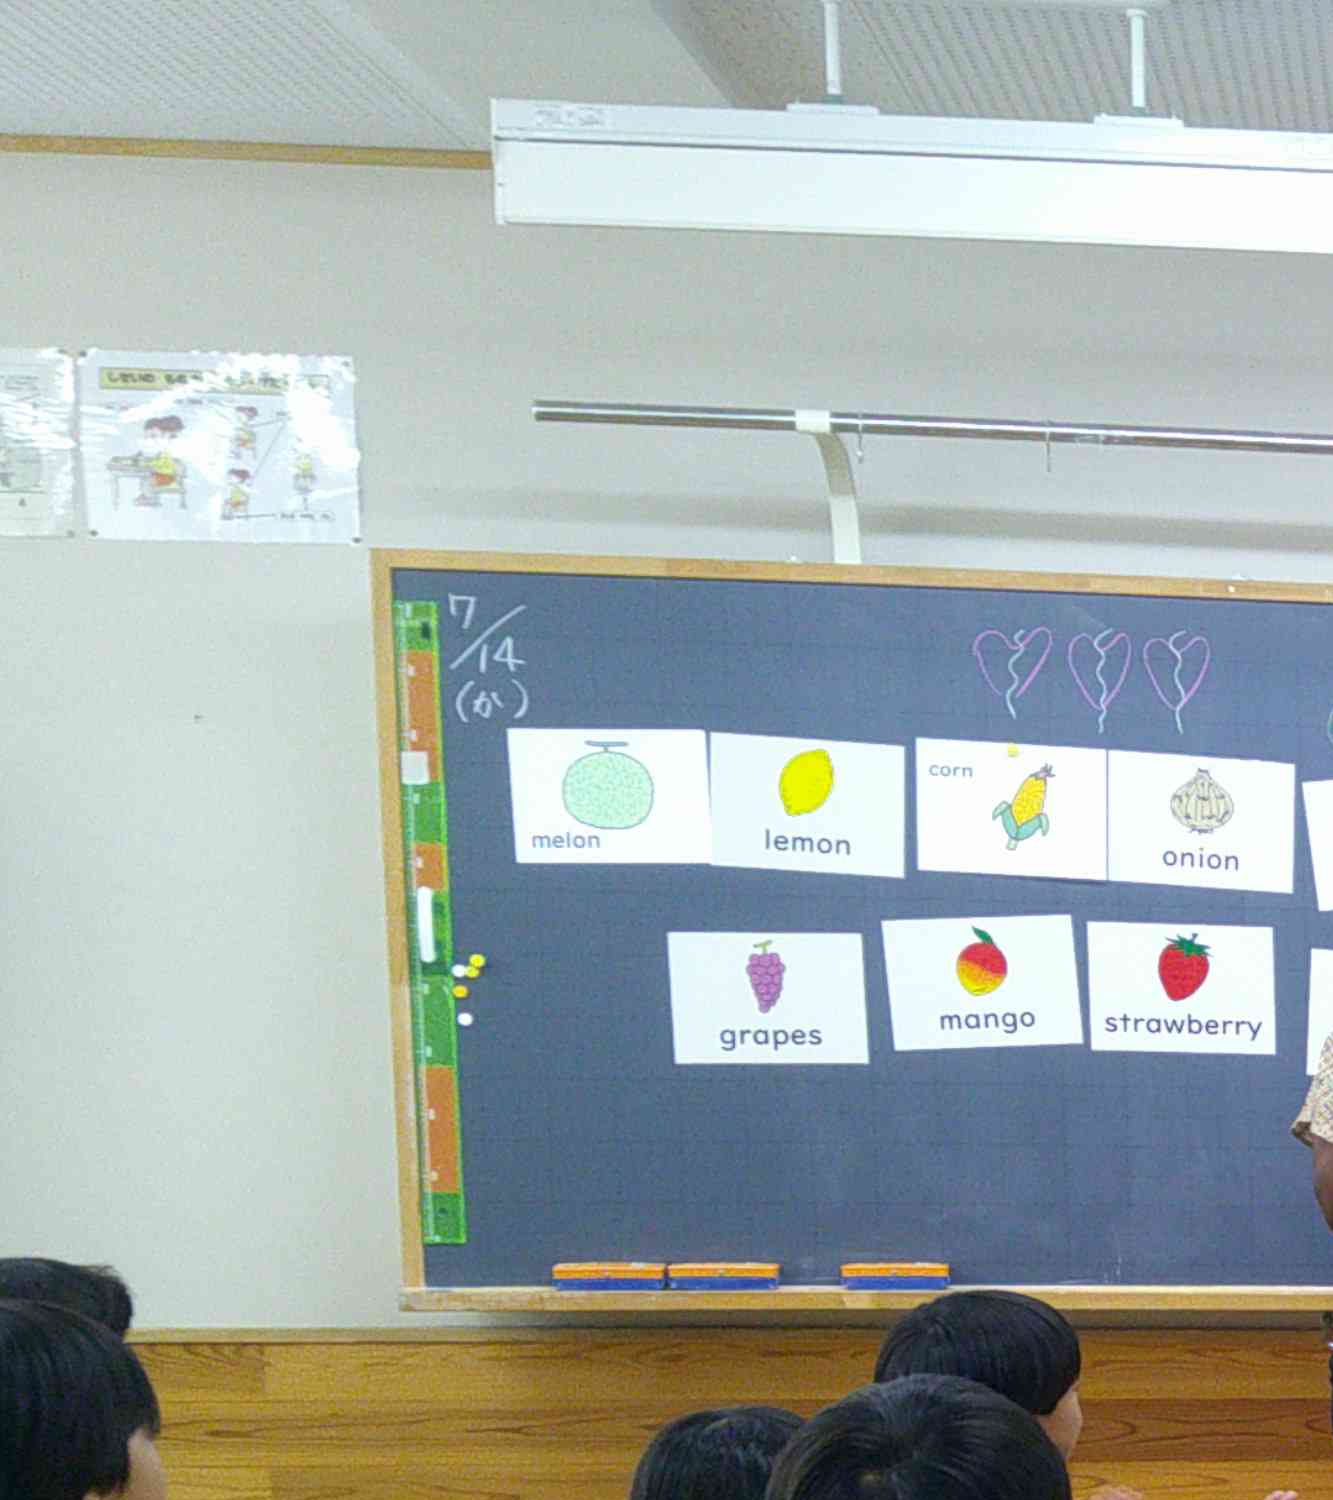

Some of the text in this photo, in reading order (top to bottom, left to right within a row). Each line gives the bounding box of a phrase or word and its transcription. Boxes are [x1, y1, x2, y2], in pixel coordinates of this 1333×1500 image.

[928, 763, 974, 778] corn
[531, 828, 601, 850] melon
[764, 827, 852, 857] lemon
[1161, 847, 1240, 873] onion
[938, 1009, 1037, 1036] mango
[1104, 1012, 1264, 1042] strawberry
[718, 1026, 824, 1053] grapes
